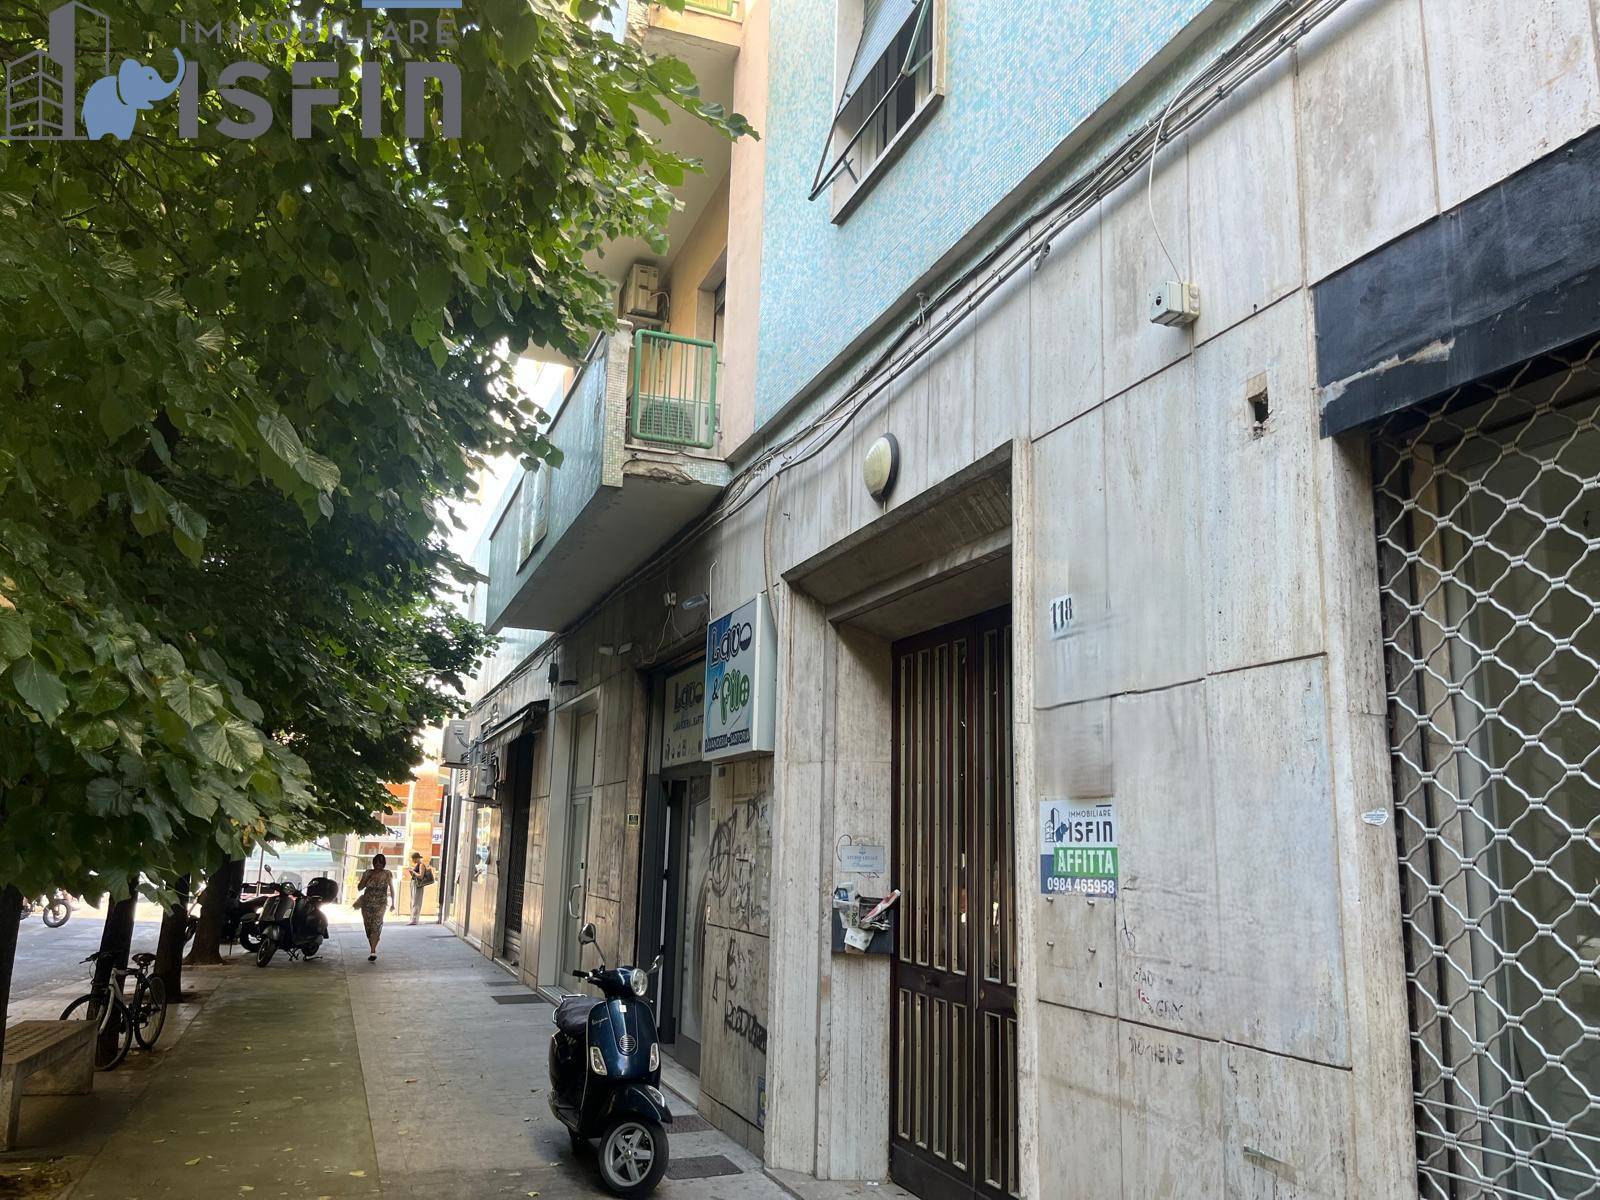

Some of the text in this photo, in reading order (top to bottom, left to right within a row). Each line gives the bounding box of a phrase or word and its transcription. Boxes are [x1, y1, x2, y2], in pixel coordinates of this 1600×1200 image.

[1050, 597, 1073, 632] 118
[1068, 810, 1112, 818] IMMOBILIARE
[1057, 849, 1115, 874] AFFITTA
[1047, 877, 1115, 894] 0984 465958
